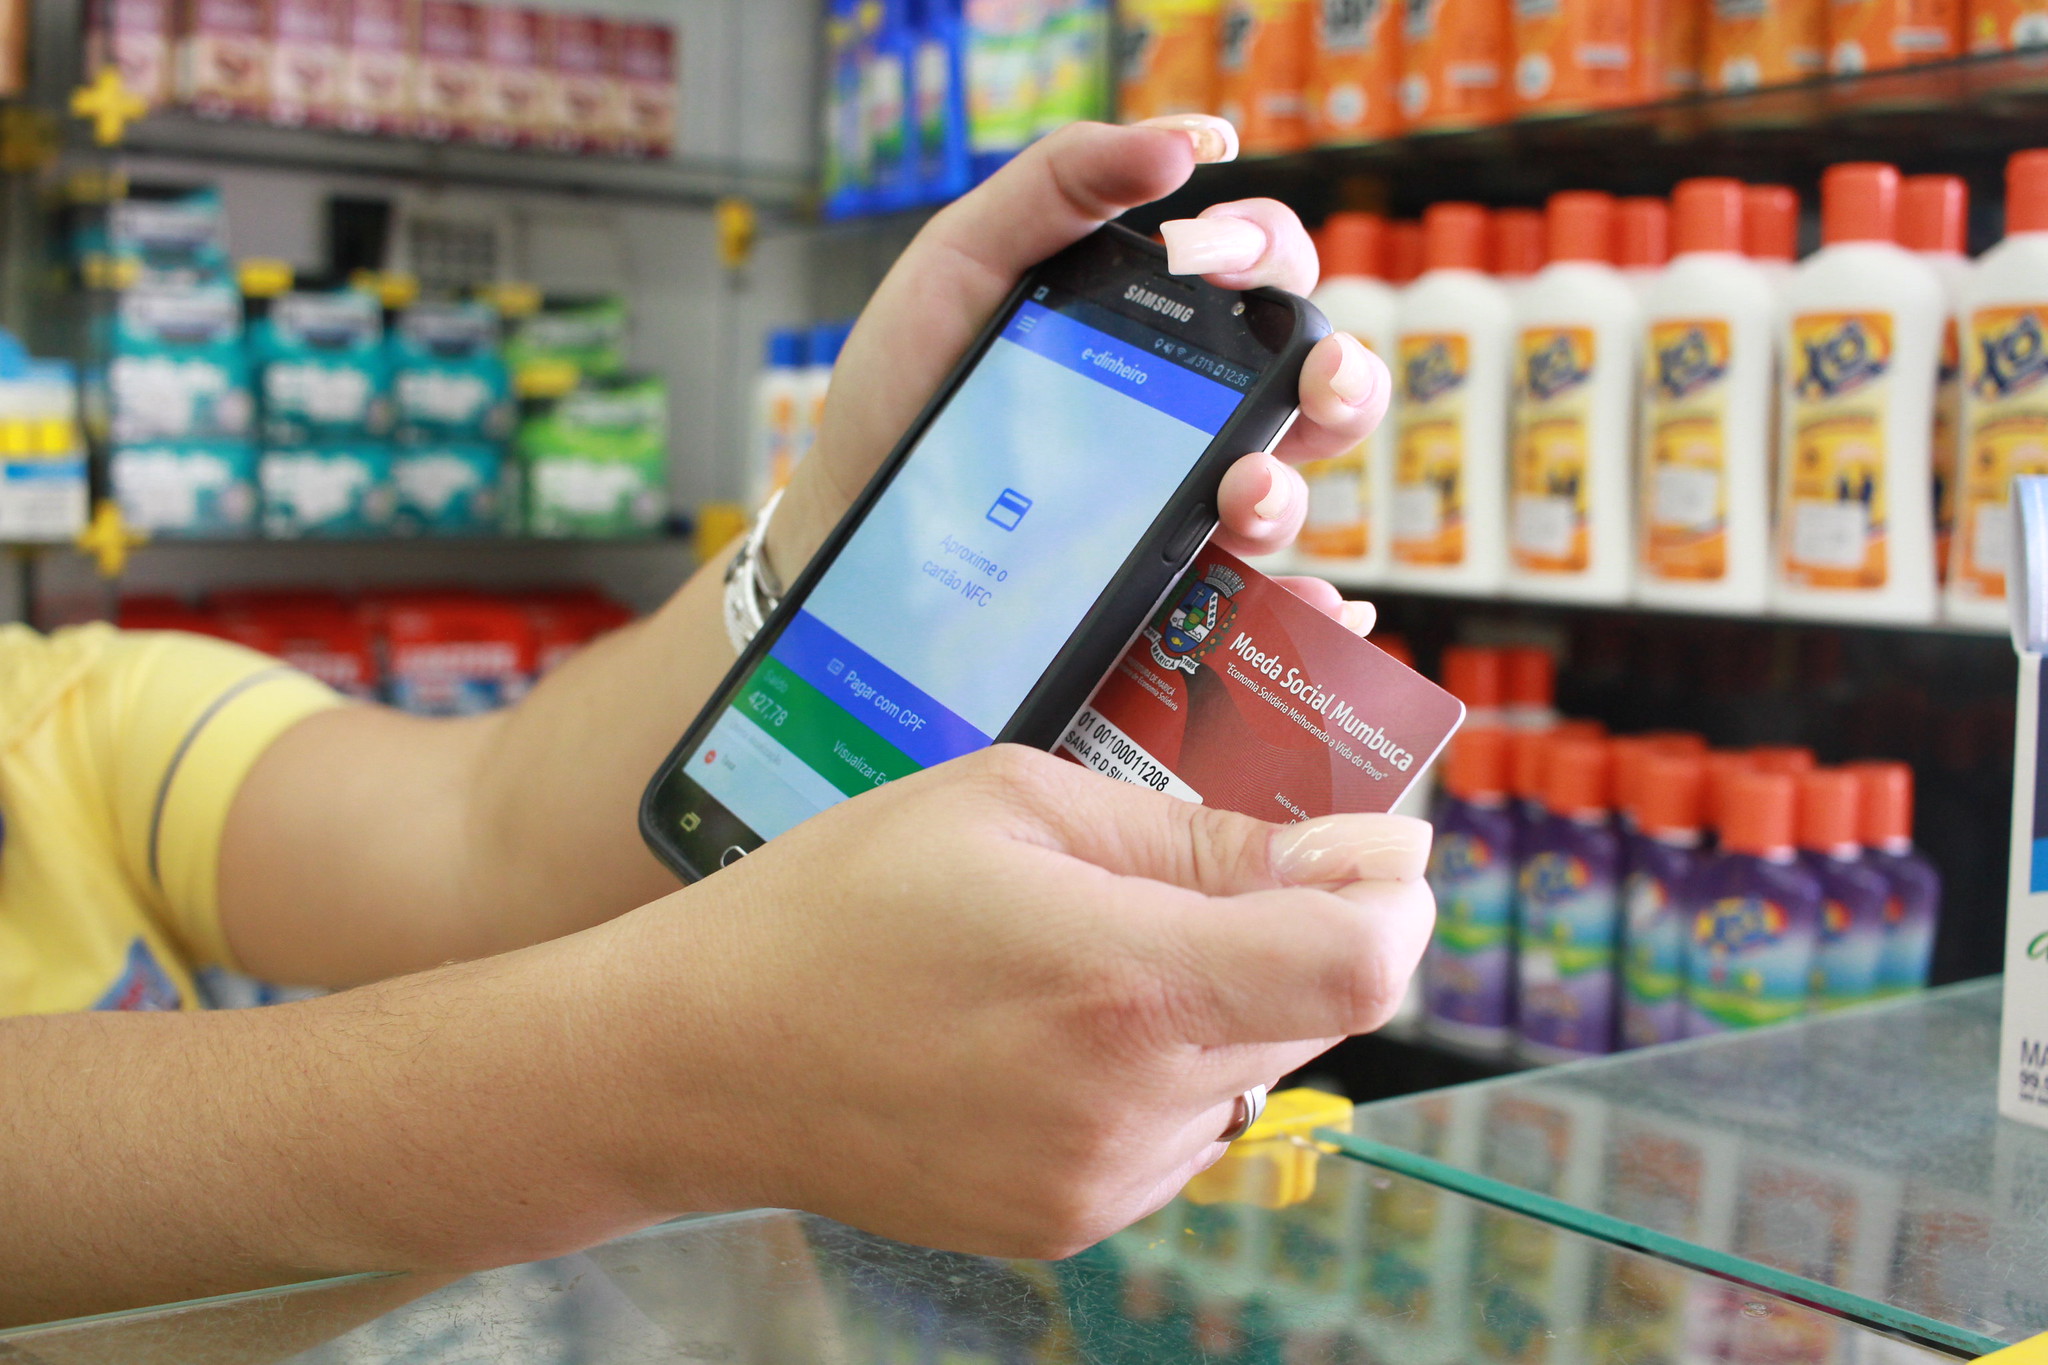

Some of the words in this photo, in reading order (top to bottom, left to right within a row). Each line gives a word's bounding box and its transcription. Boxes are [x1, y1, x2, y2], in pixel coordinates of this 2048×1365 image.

[1123, 284, 1195, 323] SAMSUNG
[1081, 347, 1148, 385] e-dinheiro
[1195, 355, 1215, 374] 31%
[1222, 365, 1250, 387] 12:35
[941, 534, 997, 577] Aproxime
[996, 570, 1009, 583] o
[922, 559, 962, 591] cartão
[961, 580, 993, 608] NFC
[1149, 674, 1159, 684] DE
[748, 690, 788, 726] 427,78
[843, 669, 877, 710] Pagar
[873, 694, 900, 718] com
[898, 709, 927, 733] CPF
[1228, 632, 1284, 681] Moeda
[1279, 667, 1337, 715] Social
[1328, 700, 1414, 772] Mumbuca
[1257, 686, 1289, 714] Solidária
[1287, 709, 1330, 745] Melhorando
[1328, 737, 1336, 747] a
[1334, 740, 1352, 760] Vida
[1351, 753, 1364, 767] do
[833, 740, 877, 779] Visualizar
[1065, 730, 1092, 759] SANA
[1089, 752, 1101, 766] R
[1098, 759, 1109, 771] D
[1078, 711, 1096, 732] 01
[1093, 724, 1170, 792] 00100011208
[1274, 792, 1291, 809] Início
[1290, 805, 1300, 815] do
